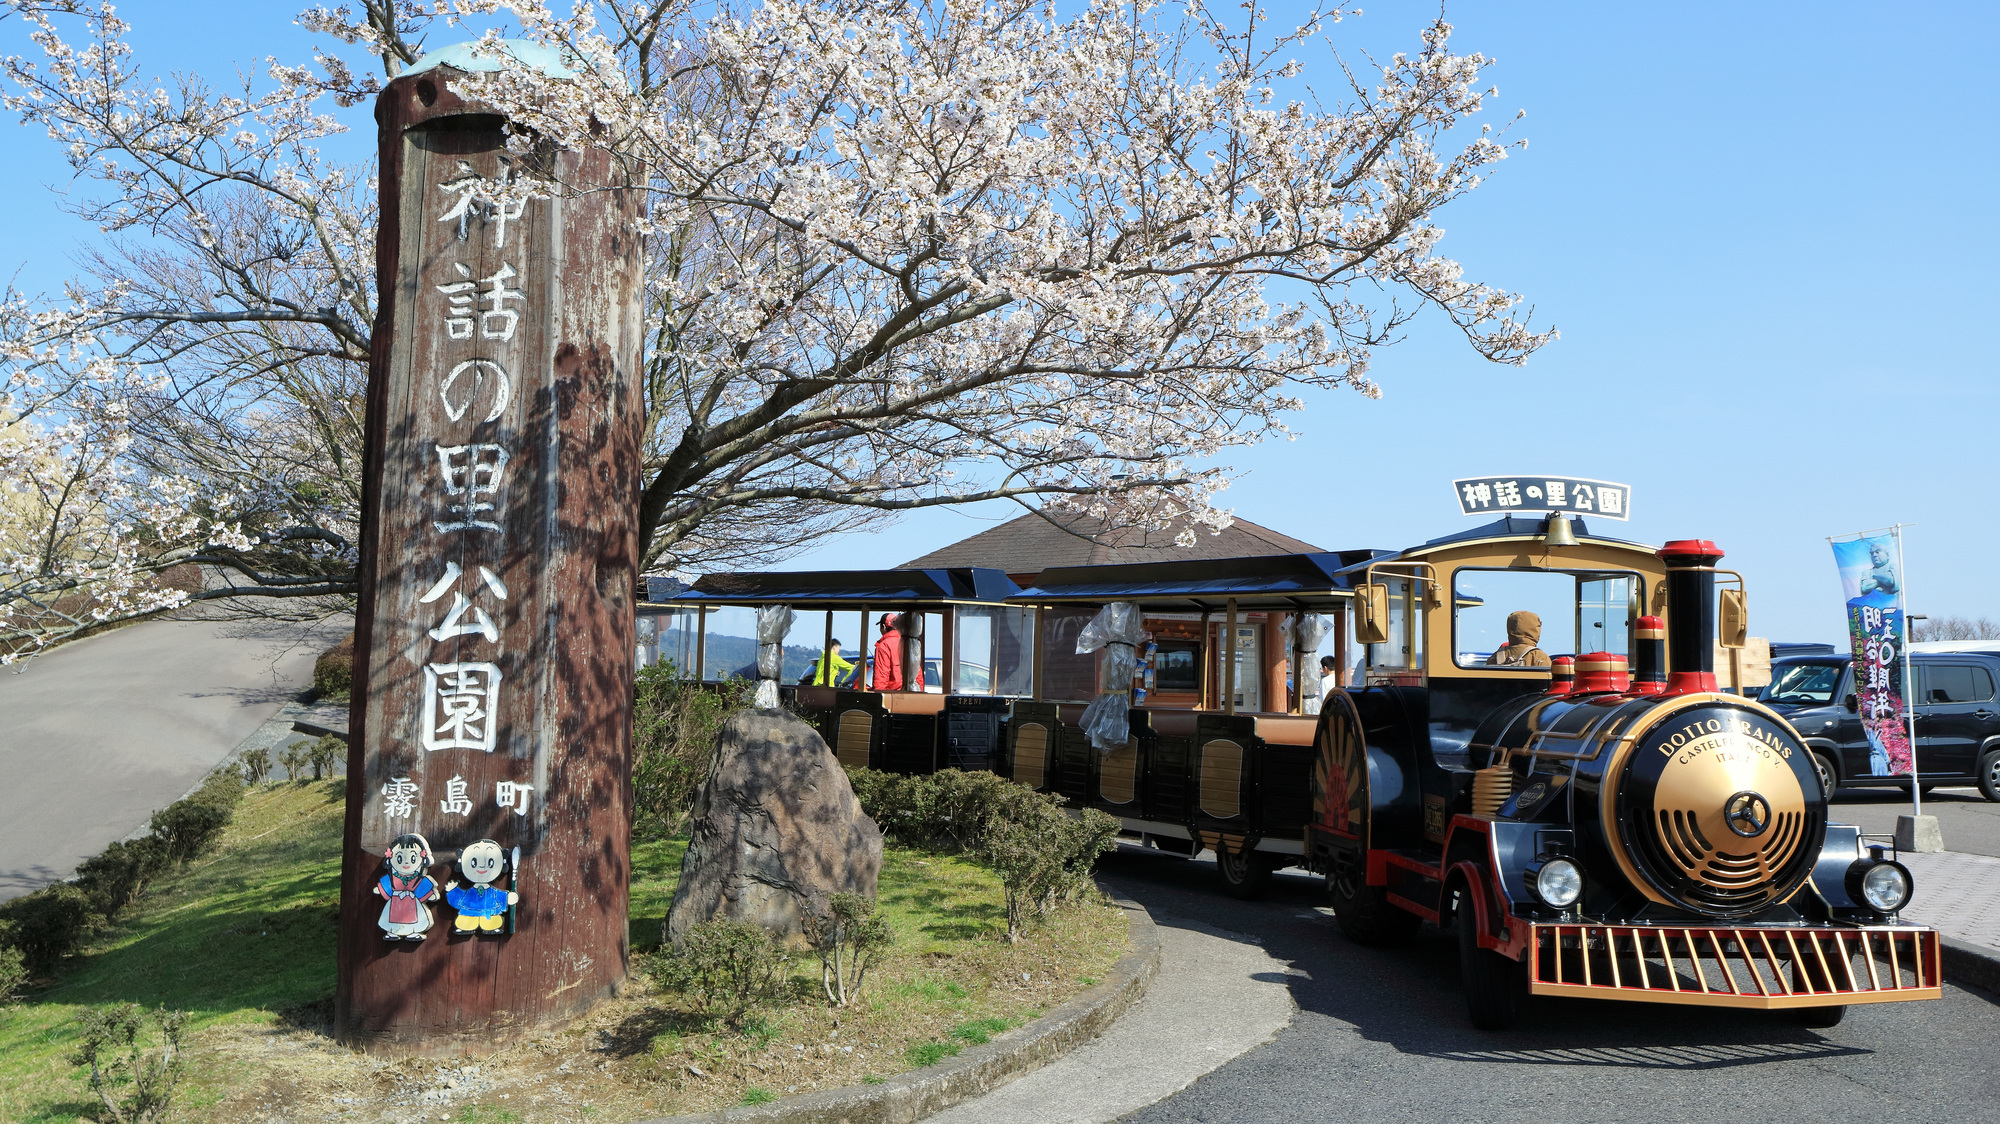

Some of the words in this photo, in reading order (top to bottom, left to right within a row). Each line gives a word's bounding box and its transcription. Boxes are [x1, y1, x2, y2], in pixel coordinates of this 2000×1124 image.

[419, 155, 527, 753] 神話の里公園
[1462, 480, 1622, 514] 神話の里公園
[1658, 718, 1722, 758] DOTTO
[1727, 718, 1793, 759] RAINS
[1679, 738, 1771, 765] CASTELFNCO
[381, 773, 534, 818] 霧島町
